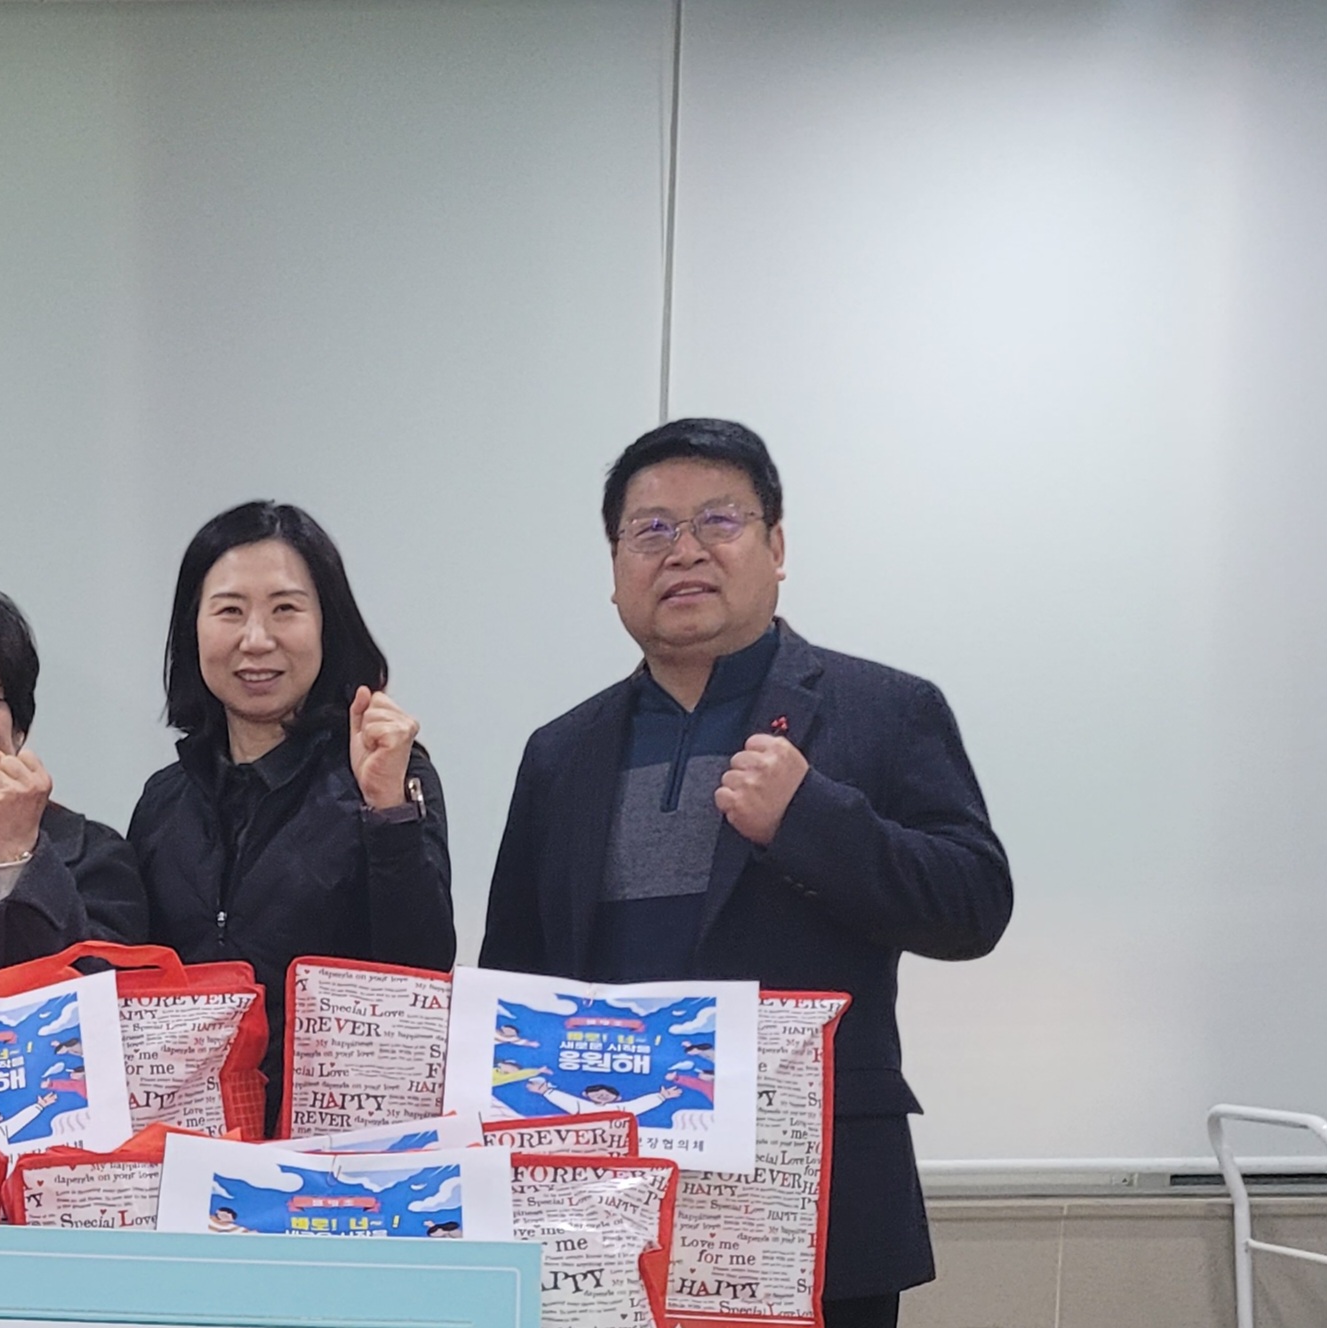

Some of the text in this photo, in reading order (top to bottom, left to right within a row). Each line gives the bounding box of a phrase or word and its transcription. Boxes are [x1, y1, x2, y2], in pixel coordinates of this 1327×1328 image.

[368, 974, 388, 982] your
[122, 994, 234, 1008] FOREVER
[320, 997, 405, 1017] Special Love
[559, 1040, 603, 1051] 새로운
[139, 1051, 158, 1060] me
[558, 1050, 651, 1074] 응원해
[150, 1063, 175, 1074] me
[318, 1063, 349, 1077] Love
[309, 1091, 386, 1111] HAPPY
[183, 1106, 204, 1115] Love
[186, 1117, 205, 1127] me
[483, 1128, 607, 1149] FOREVER
[638, 1137, 704, 1151] 장협의체
[113, 1172, 135, 1182] your
[512, 1166, 645, 1183] FOREVER
[60, 1213, 115, 1228] Special
[556, 1237, 588, 1251] me
[680, 1237, 739, 1250] Love me
[697, 1250, 756, 1265] for me
[676, 1278, 760, 1300] HAPPY
